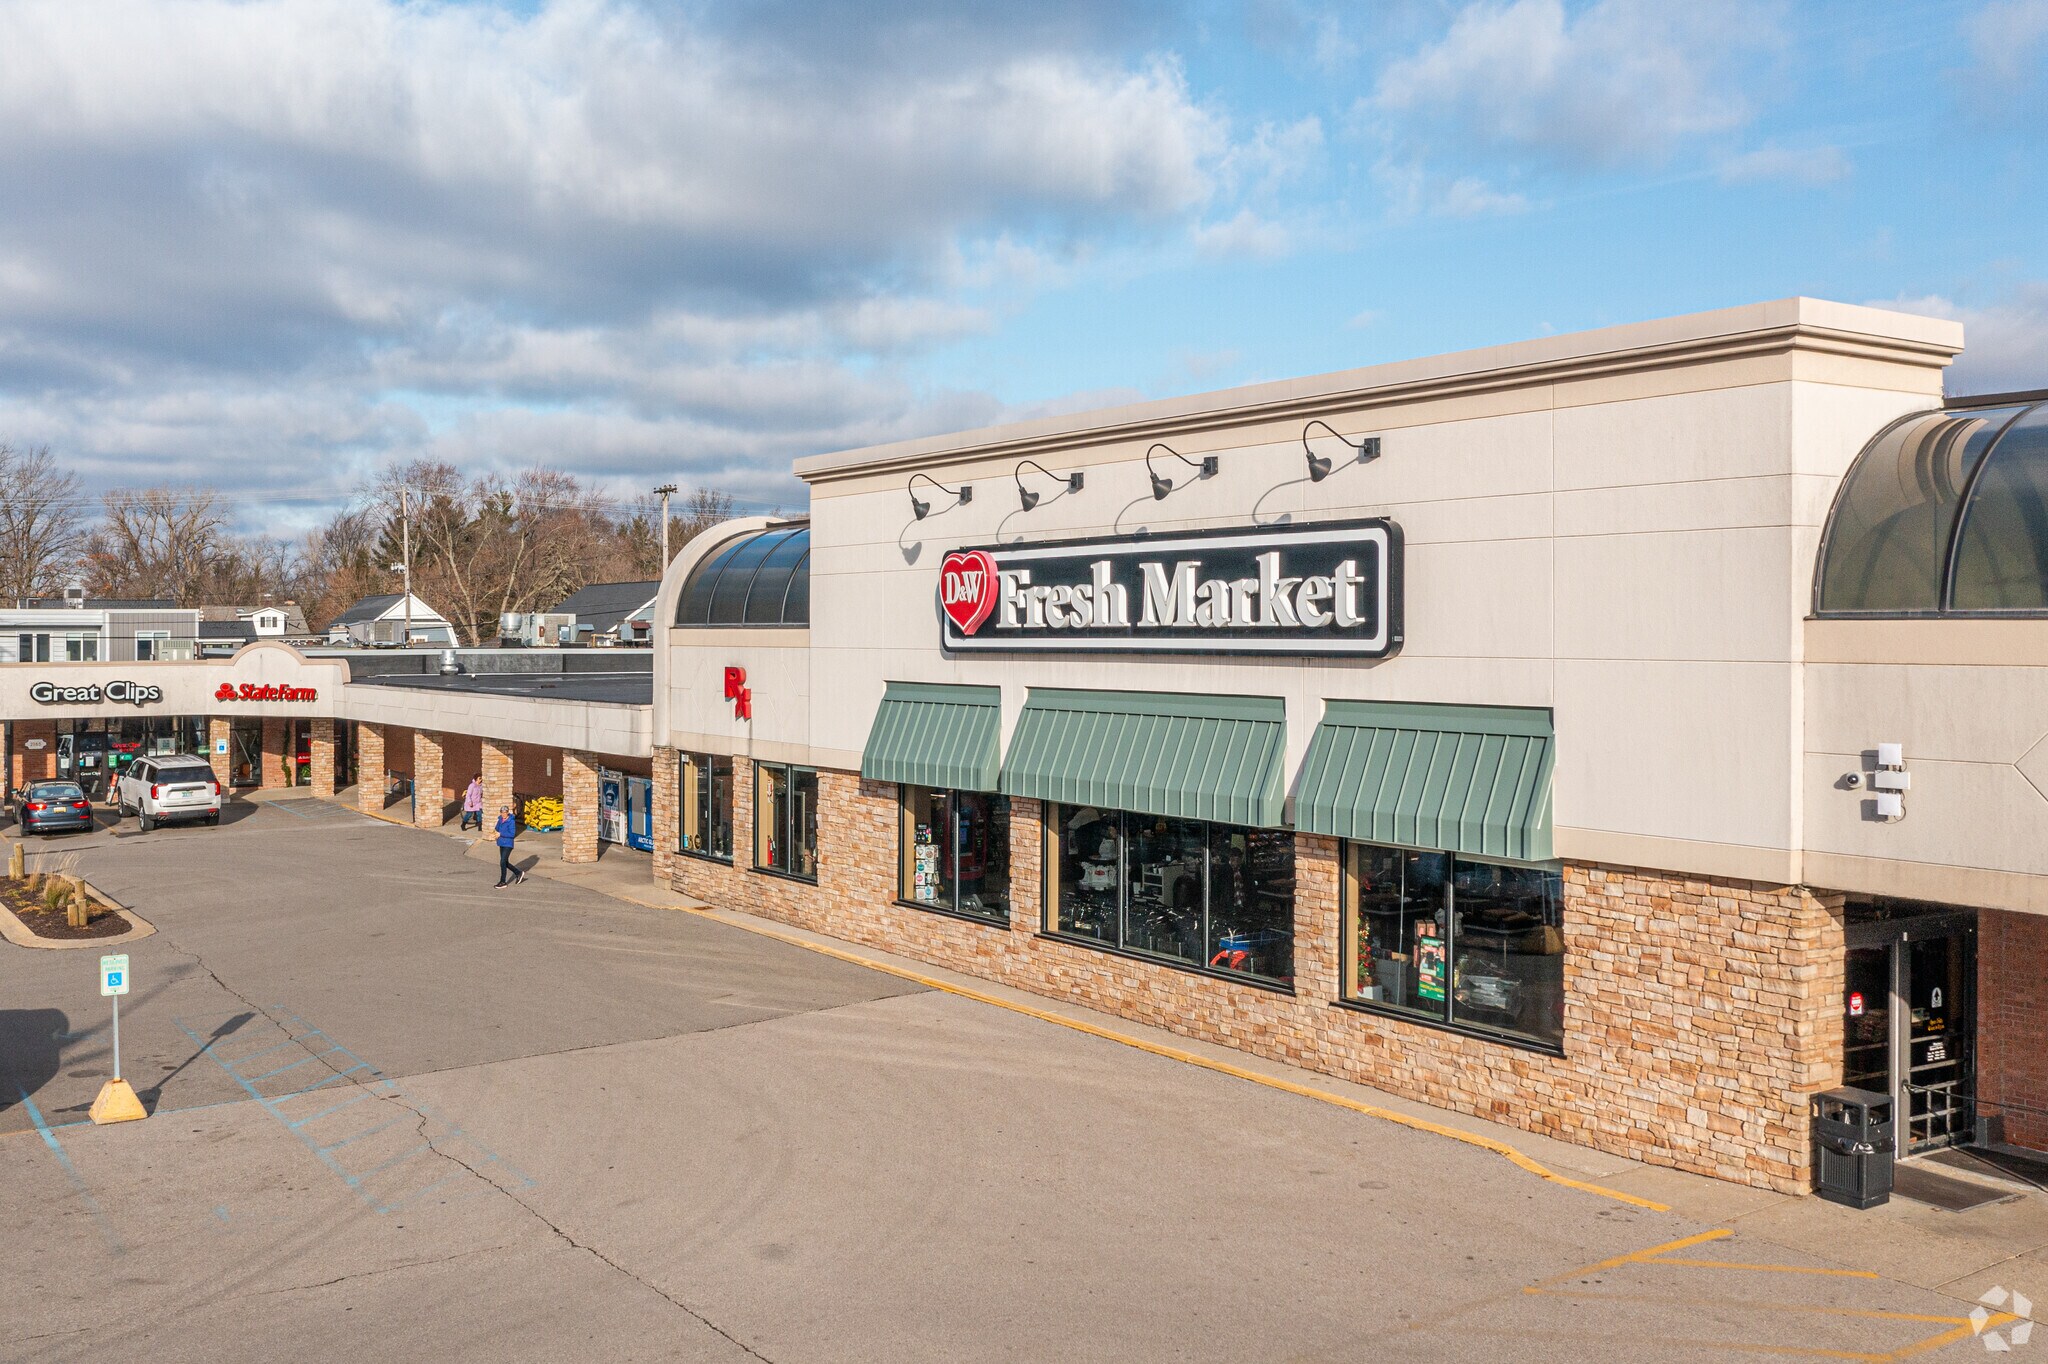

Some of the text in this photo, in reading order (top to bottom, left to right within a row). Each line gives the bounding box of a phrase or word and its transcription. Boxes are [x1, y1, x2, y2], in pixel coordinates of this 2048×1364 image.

[944, 551, 1366, 629] D&W Fresh Market
[31, 680, 160, 705] Great Clips
